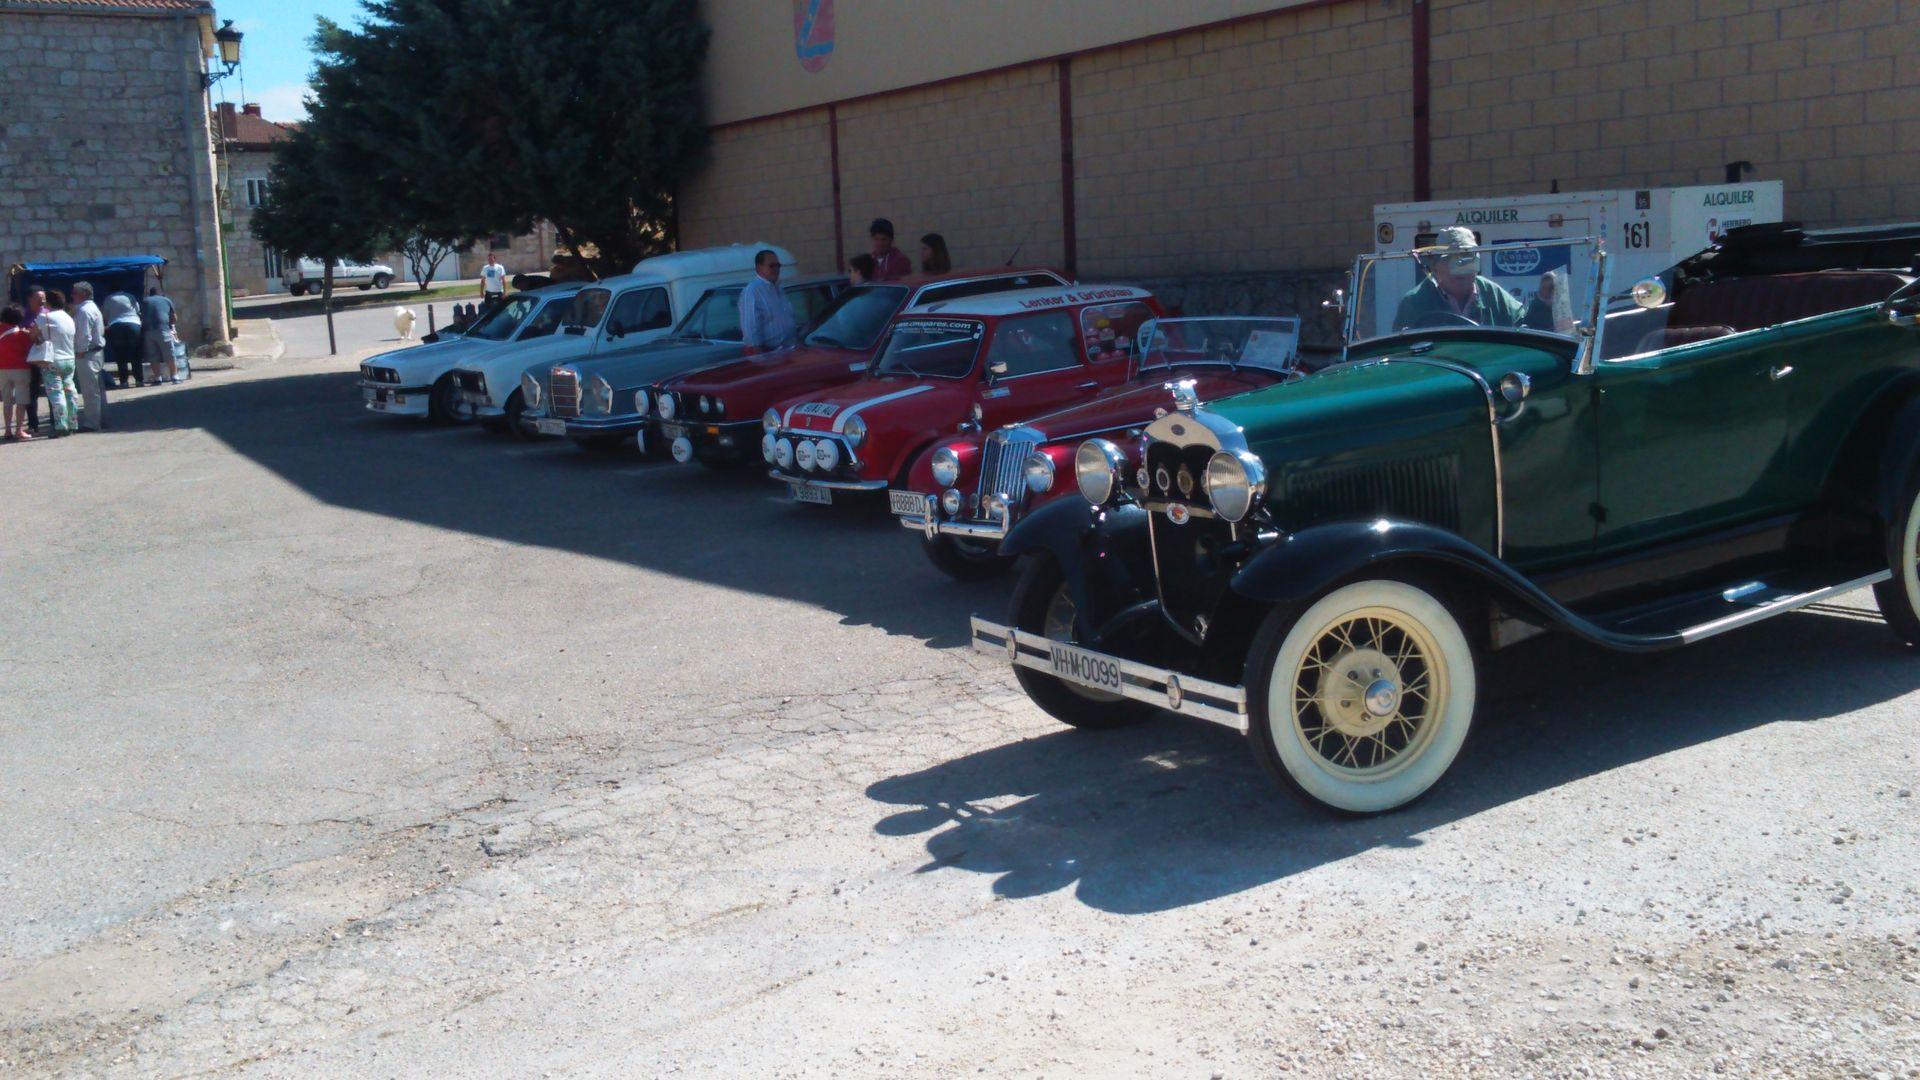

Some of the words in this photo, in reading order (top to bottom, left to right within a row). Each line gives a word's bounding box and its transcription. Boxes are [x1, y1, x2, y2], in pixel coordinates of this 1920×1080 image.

[1703, 190, 1754, 207] ALQUILER
[1456, 209, 1518, 223] ALQUILER
[1624, 221, 1650, 249] 161
[1019, 295, 1064, 308] Lenker
[1066, 293, 1078, 302] &
